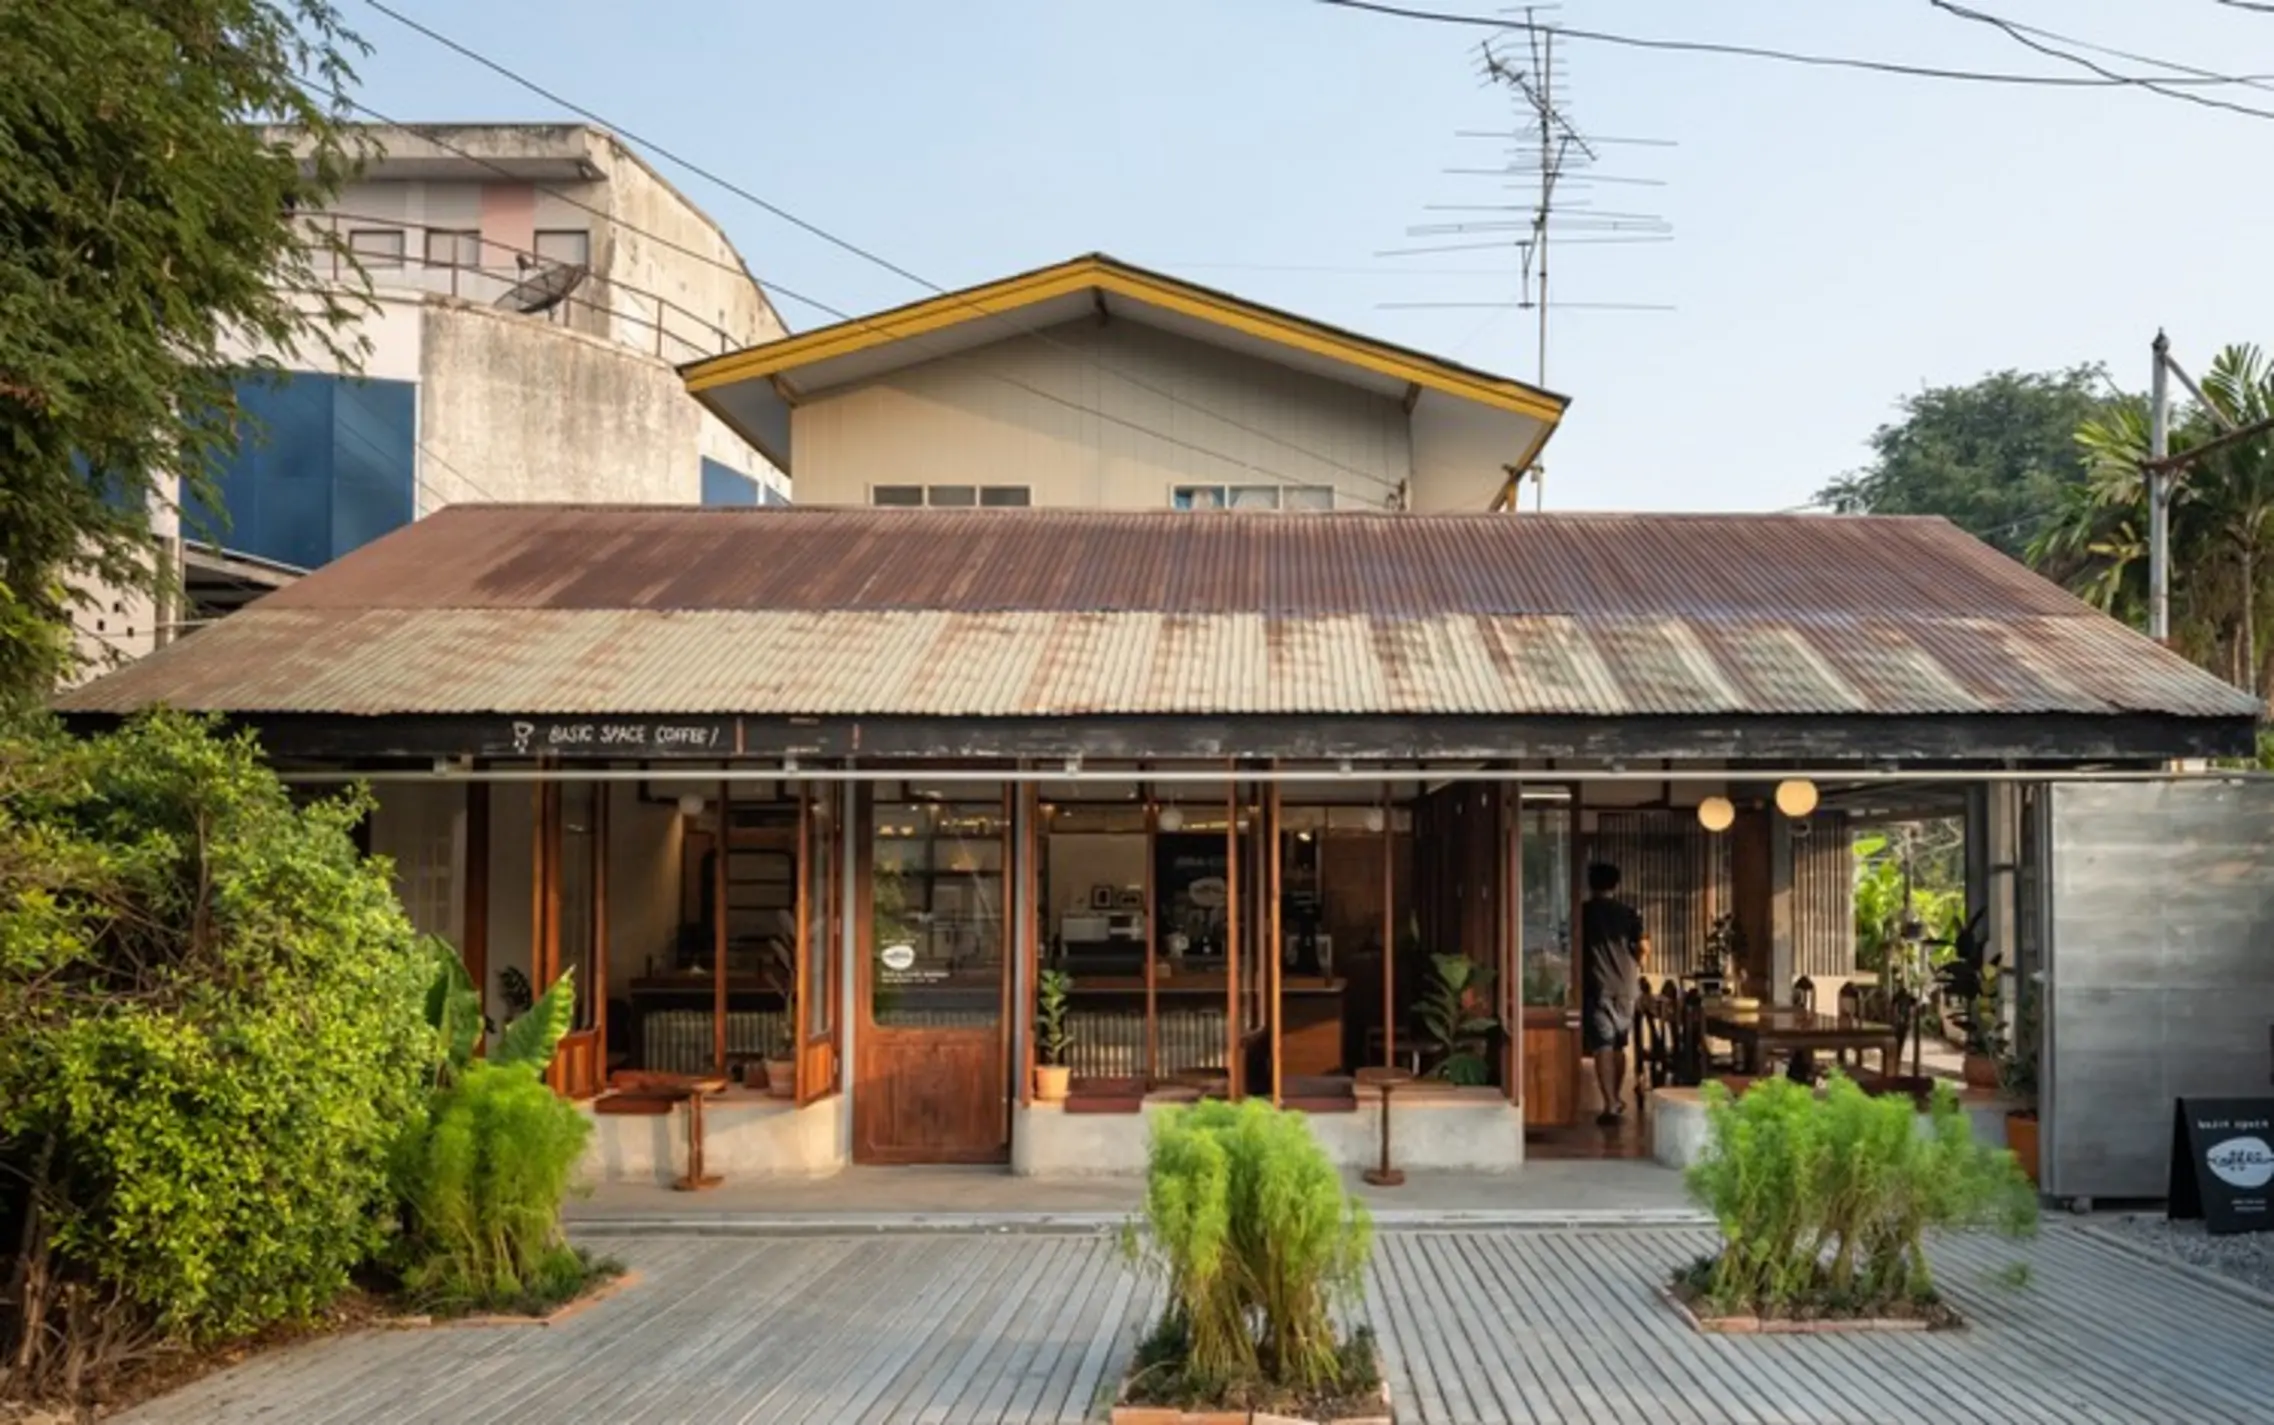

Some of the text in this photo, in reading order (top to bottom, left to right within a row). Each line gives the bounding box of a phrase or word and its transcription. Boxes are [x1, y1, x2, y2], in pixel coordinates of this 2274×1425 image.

[549, 724, 594, 744] BASIC
[599, 724, 646, 744] SPACE
[654, 725, 708, 744] COFFEE
